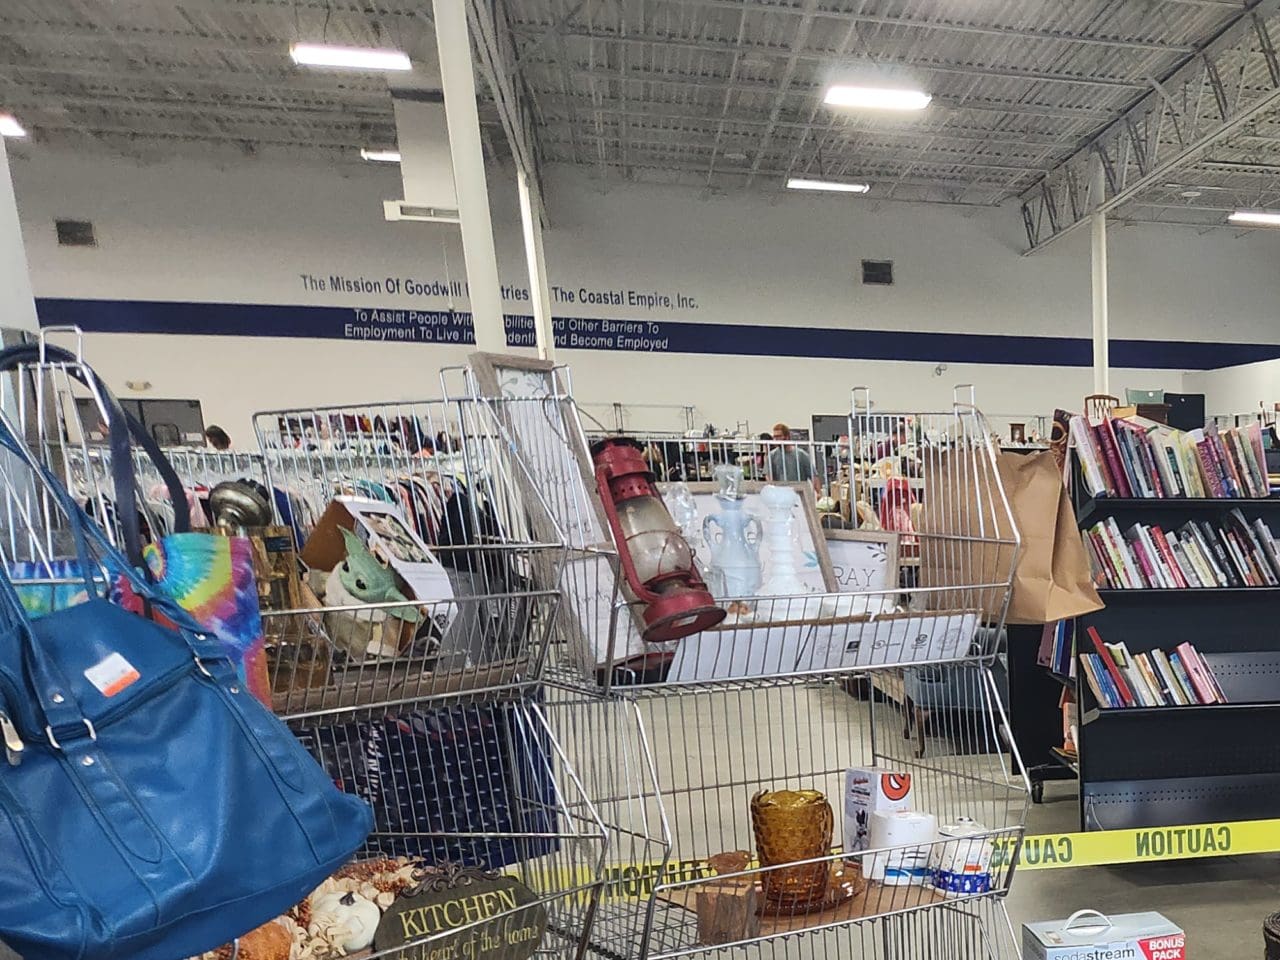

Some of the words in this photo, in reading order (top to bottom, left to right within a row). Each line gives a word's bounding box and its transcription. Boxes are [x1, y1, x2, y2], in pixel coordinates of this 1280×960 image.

[301, 274, 326, 292] The
[329, 276, 382, 294] Mission
[385, 278, 400, 294] Of
[405, 279, 462, 297] Goodwill
[552, 286, 575, 303] The
[579, 288, 625, 305] Coastal
[628, 290, 674, 310] Empire,
[677, 292, 699, 309] Inc.
[355, 309, 368, 322] To
[371, 310, 406, 324] Assist
[409, 311, 448, 330] People
[568, 318, 599, 333] Other
[602, 320, 643, 334] Barriers
[647, 322, 660, 335] To
[344, 324, 416, 341] Employment
[419, 327, 433, 340] To
[436, 327, 459, 342] Live
[570, 335, 613, 348] Become
[617, 337, 668, 352] Employed
[398, 887, 518, 939] KITCHEN
[480, 925, 501, 952] the
[1149, 938, 1185, 951] BONUS
[1152, 949, 1182, 960] PACK
